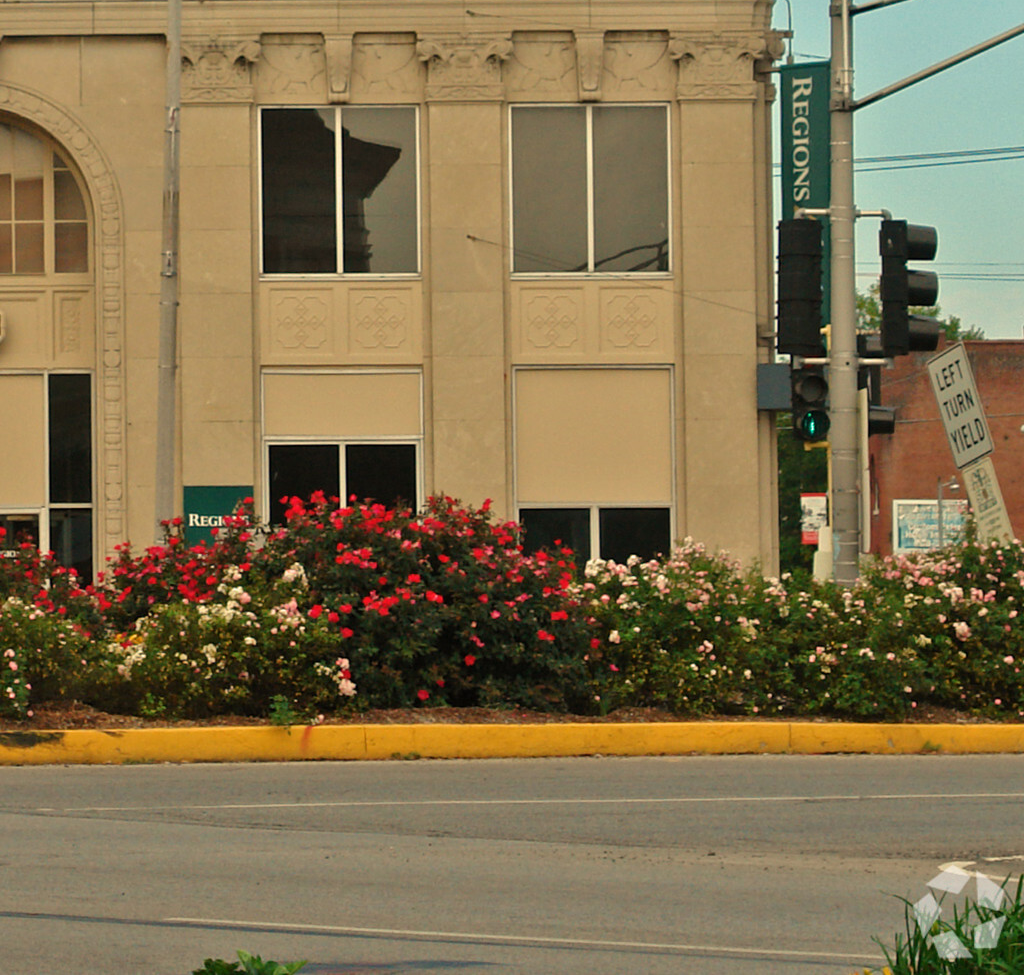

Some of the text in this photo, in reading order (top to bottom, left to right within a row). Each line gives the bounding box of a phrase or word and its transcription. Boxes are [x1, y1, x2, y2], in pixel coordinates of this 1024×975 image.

[792, 76, 813, 202] REGIONS
[936, 359, 963, 392] LEFT
[943, 388, 974, 421] TURN
[950, 418, 985, 454] YIELD
[189, 513, 250, 527] REGI
